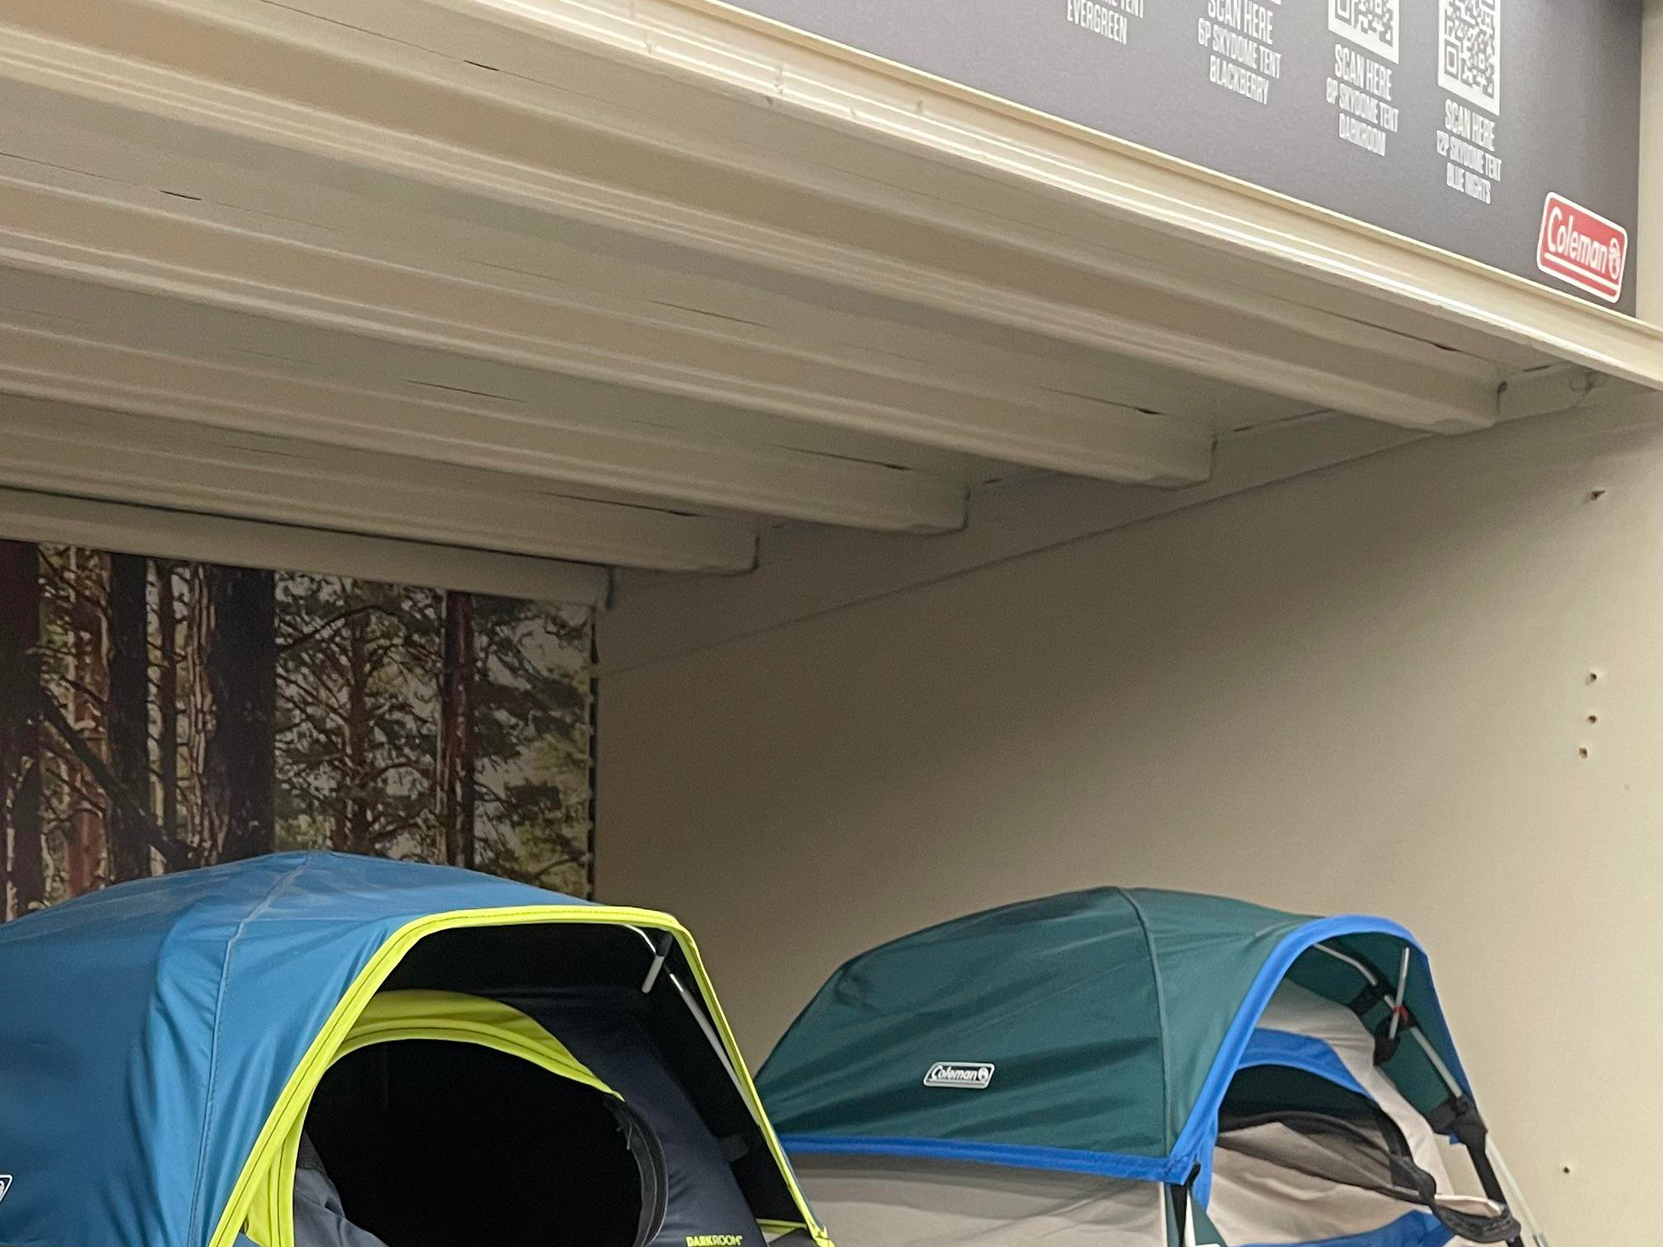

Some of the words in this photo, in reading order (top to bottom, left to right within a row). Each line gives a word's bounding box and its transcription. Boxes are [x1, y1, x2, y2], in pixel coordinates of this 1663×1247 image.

[1067, 0, 1127, 45] EVERGREEN
[1243, 0, 1274, 44] HERE
[1209, 54, 1269, 105] BLACKBERRY
[1259, 45, 1282, 79] TENT
[1334, 43, 1364, 89] SCAN
[1365, 58, 1392, 101] HERE
[1445, 99, 1471, 140] SCAN
[1471, 112, 1495, 151] HERE
[1547, 206, 1608, 274] Coleman
[931, 1065, 978, 1081] Coleman
